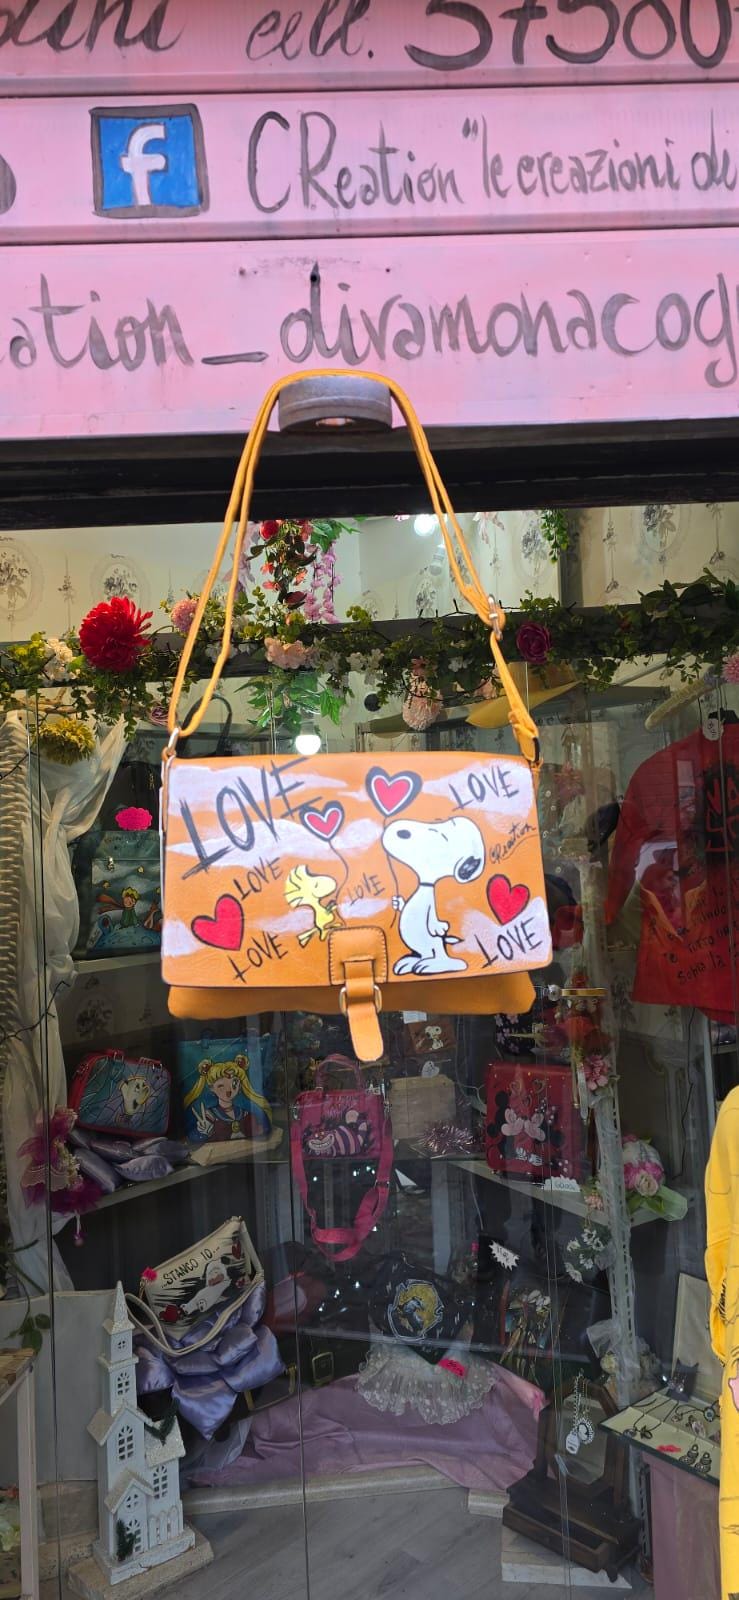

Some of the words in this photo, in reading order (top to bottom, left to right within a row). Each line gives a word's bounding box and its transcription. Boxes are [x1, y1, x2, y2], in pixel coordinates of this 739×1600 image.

[246, 0, 374, 61] cell.
[517, 138, 681, 198] creazioni
[691, 108, 738, 192] di
[449, 766, 519, 812] LOVE
[179, 757, 322, 880] LOVE
[233, 856, 284, 901] LOVE
[347, 872, 386, 906] LOVE
[226, 931, 288, 983] LOVE
[474, 917, 542, 969] LOVE
